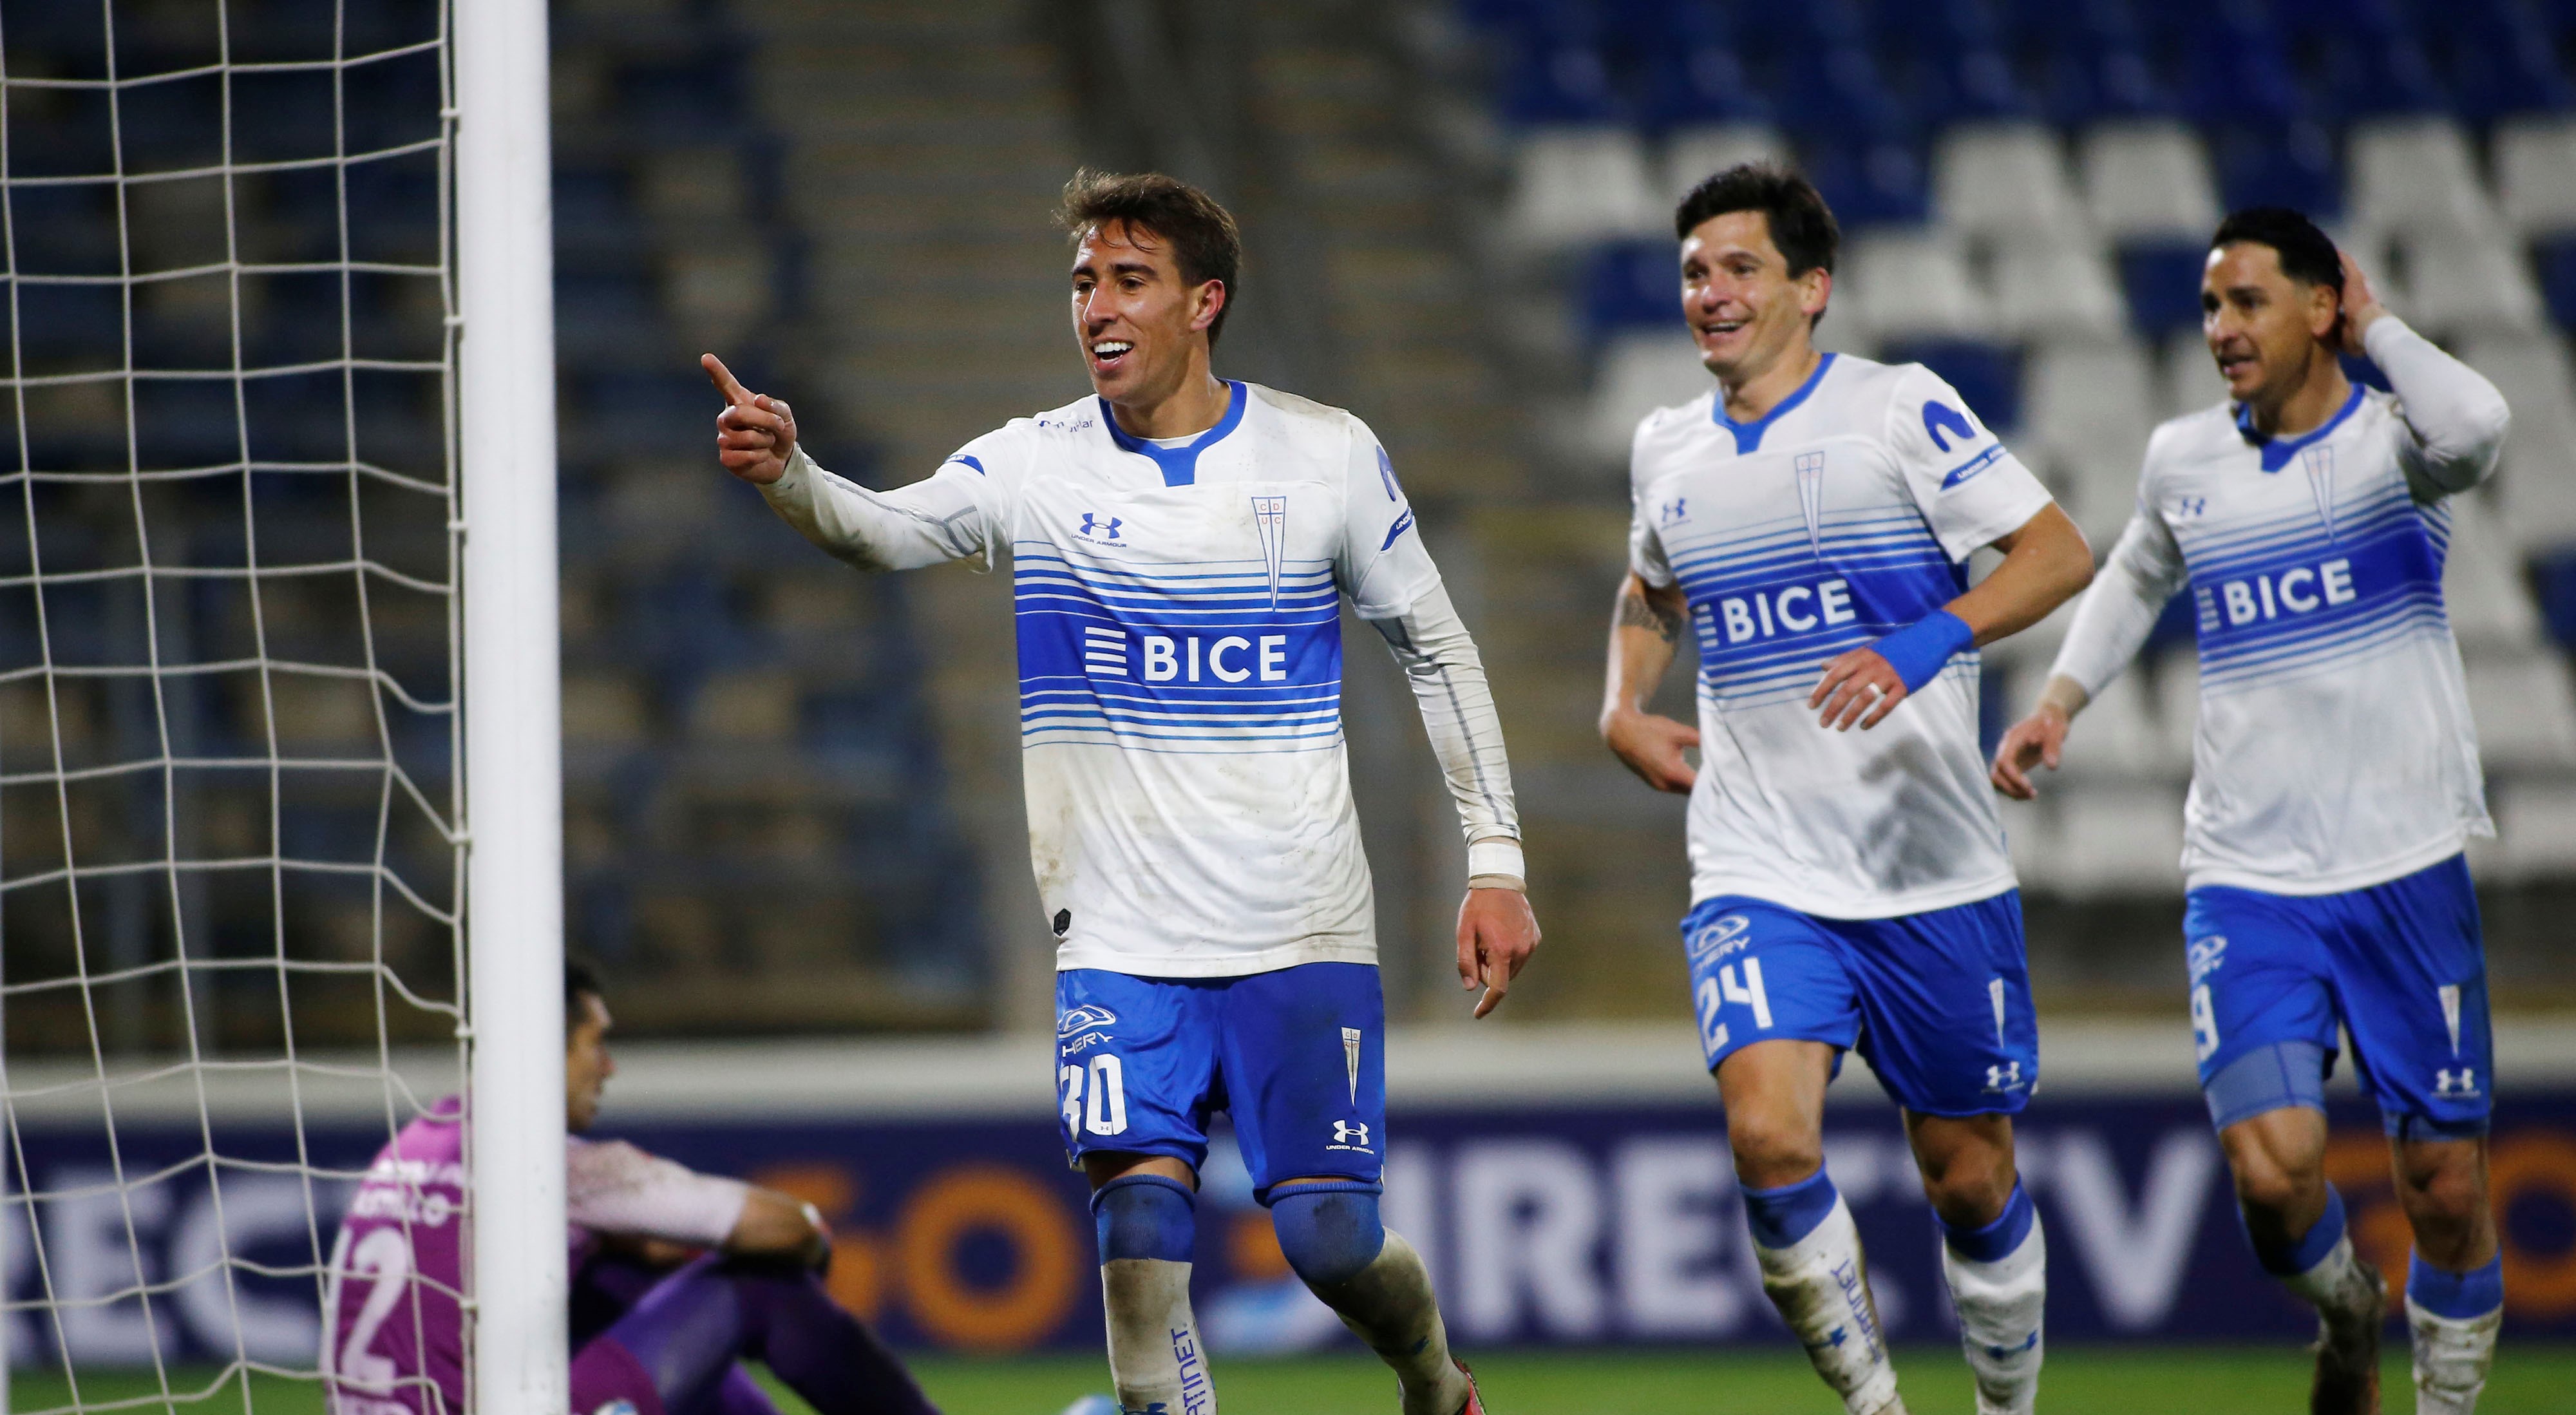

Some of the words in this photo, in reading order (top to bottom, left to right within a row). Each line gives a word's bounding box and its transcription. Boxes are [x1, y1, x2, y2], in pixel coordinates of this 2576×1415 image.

[1071, 534, 1094, 543] UNDER
[1722, 579, 1856, 643] BICE
[2224, 558, 2356, 626] BICE
[1144, 634, 1286, 683] BICE
[1698, 956, 1773, 1058] 24
[1063, 1032, 1113, 1057] HERY
[1059, 1053, 1128, 1143] 30
[1352, 1146, 1374, 1155] ARMOUR
